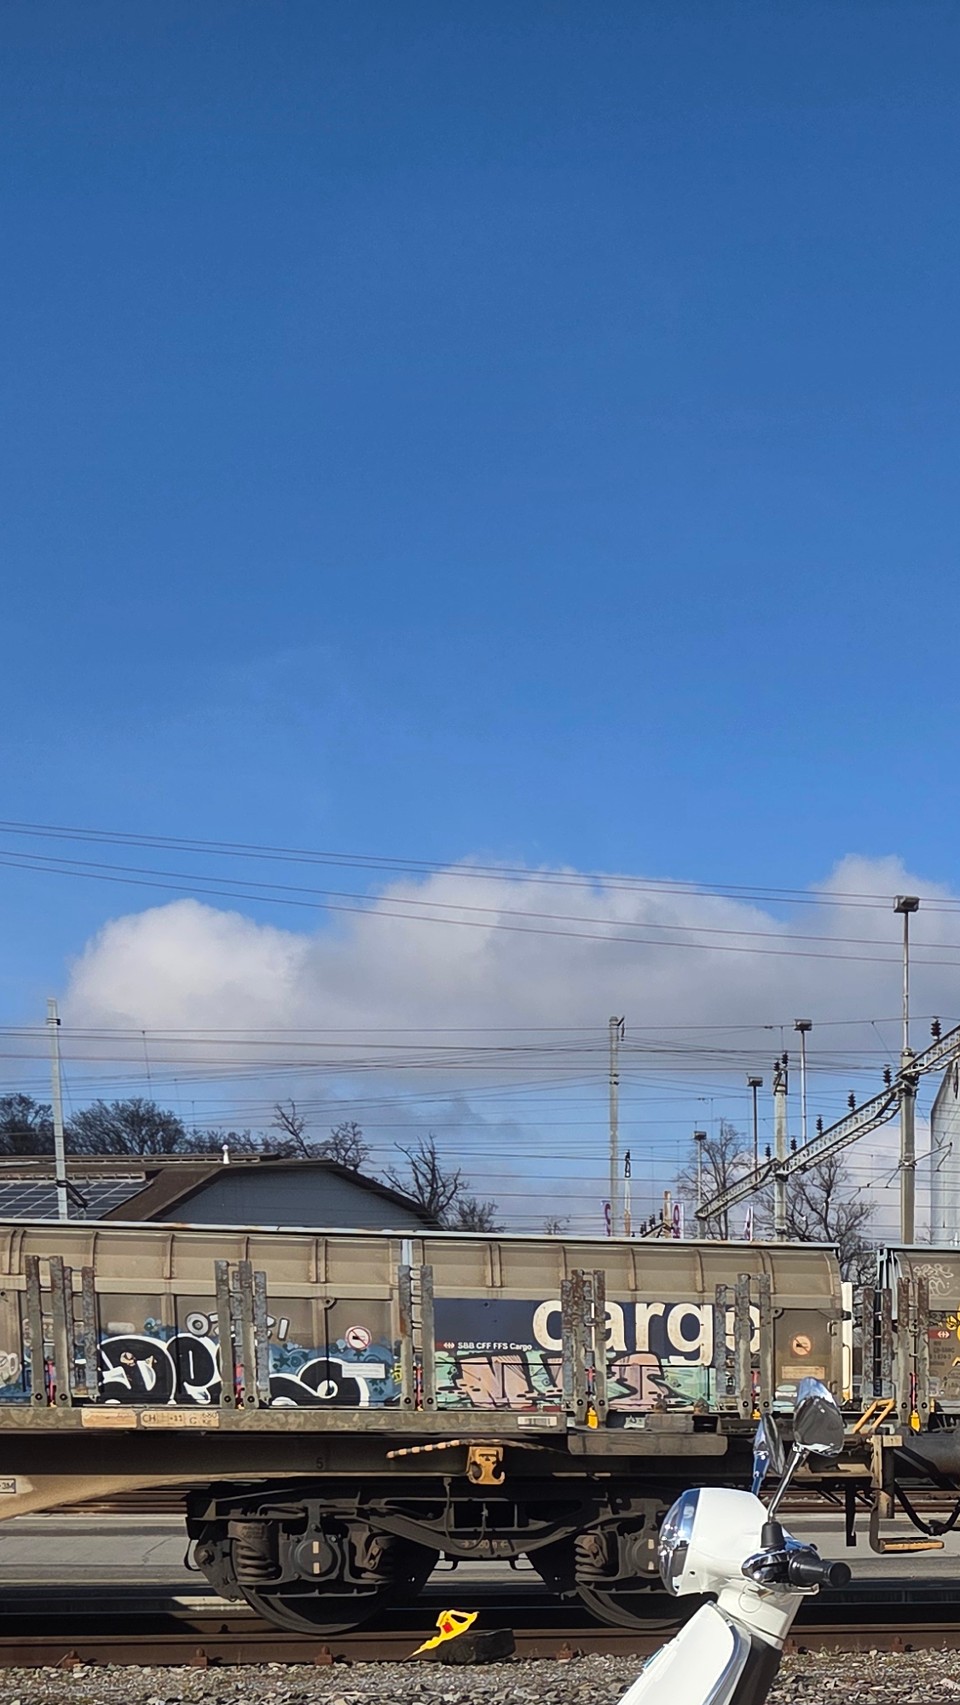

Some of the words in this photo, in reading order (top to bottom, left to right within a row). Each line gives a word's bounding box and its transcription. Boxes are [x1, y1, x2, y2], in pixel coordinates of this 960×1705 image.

[457, 1341, 475, 1350] SBB
[476, 1342, 491, 1350] CFF
[493, 1342, 508, 1350] FFS
[509, 1343, 533, 1351] Cargo
